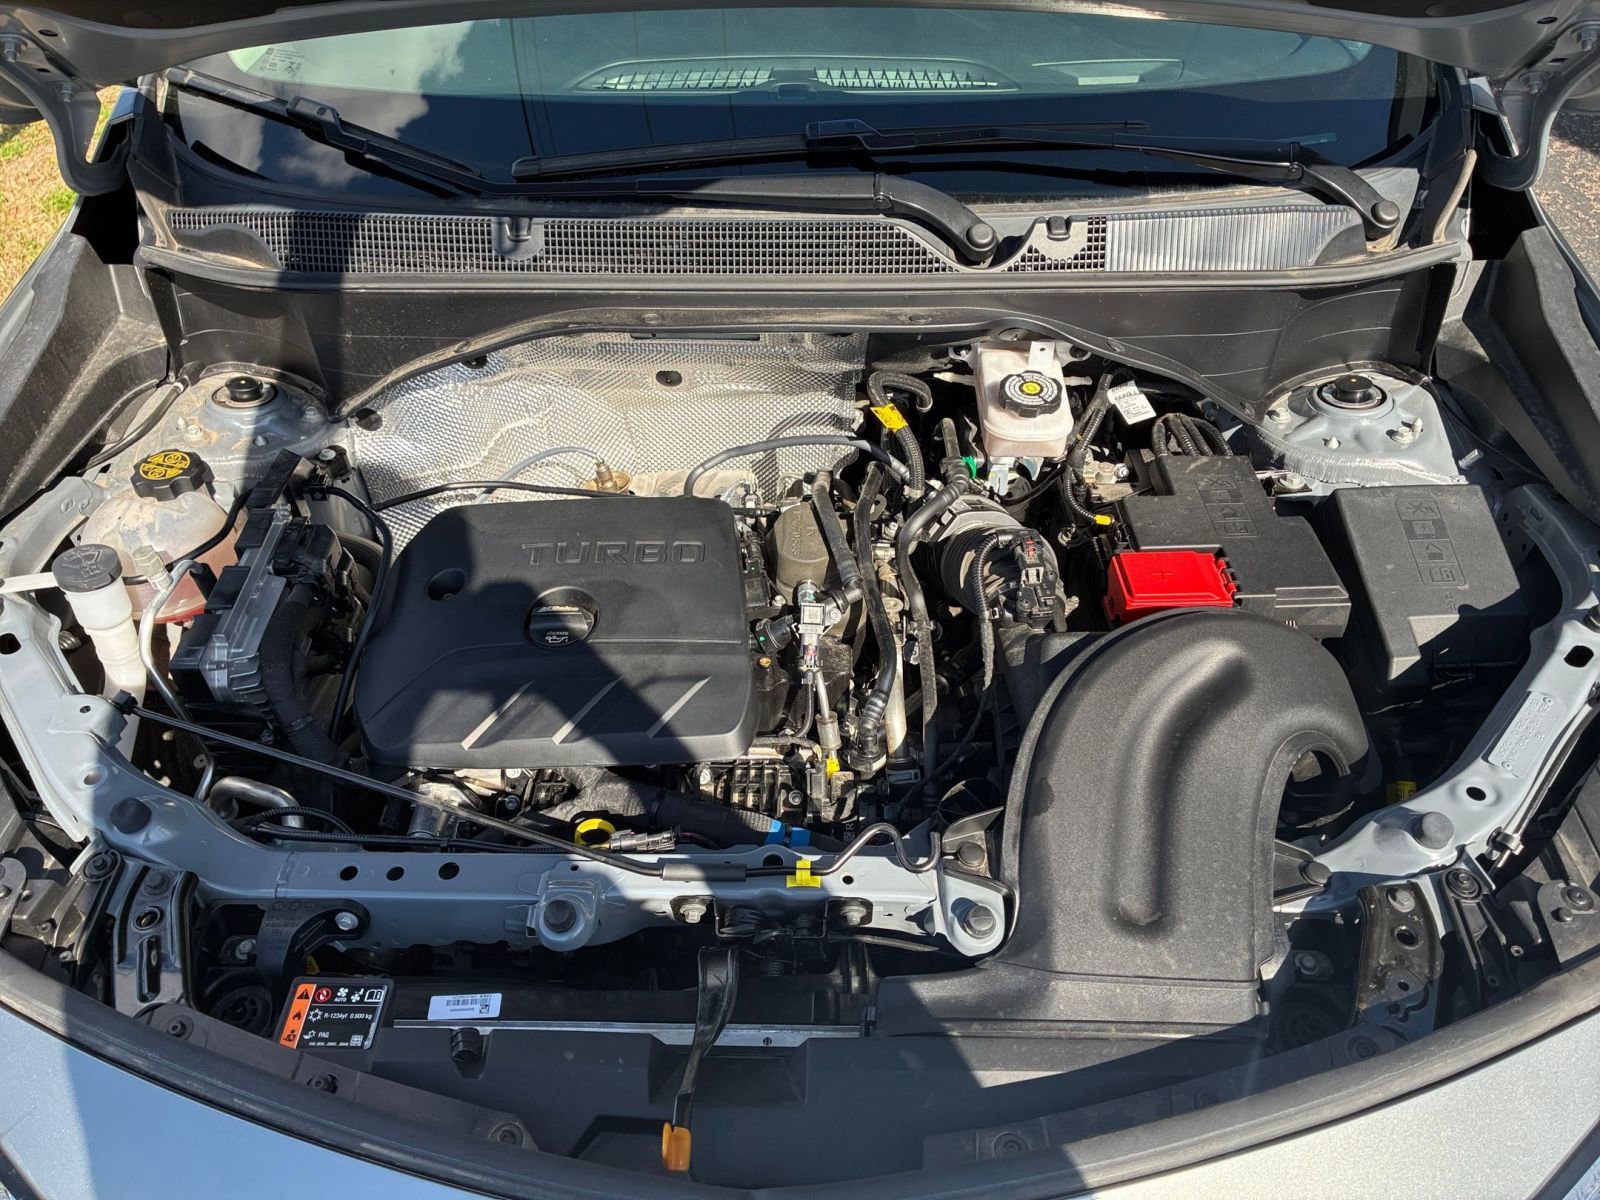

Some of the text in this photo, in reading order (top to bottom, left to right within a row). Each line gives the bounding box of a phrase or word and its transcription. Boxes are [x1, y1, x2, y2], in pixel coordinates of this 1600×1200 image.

[521, 541, 705, 566] TURBO
[365, 1013, 373, 1021] kg
[317, 1031, 330, 1039] PAG
